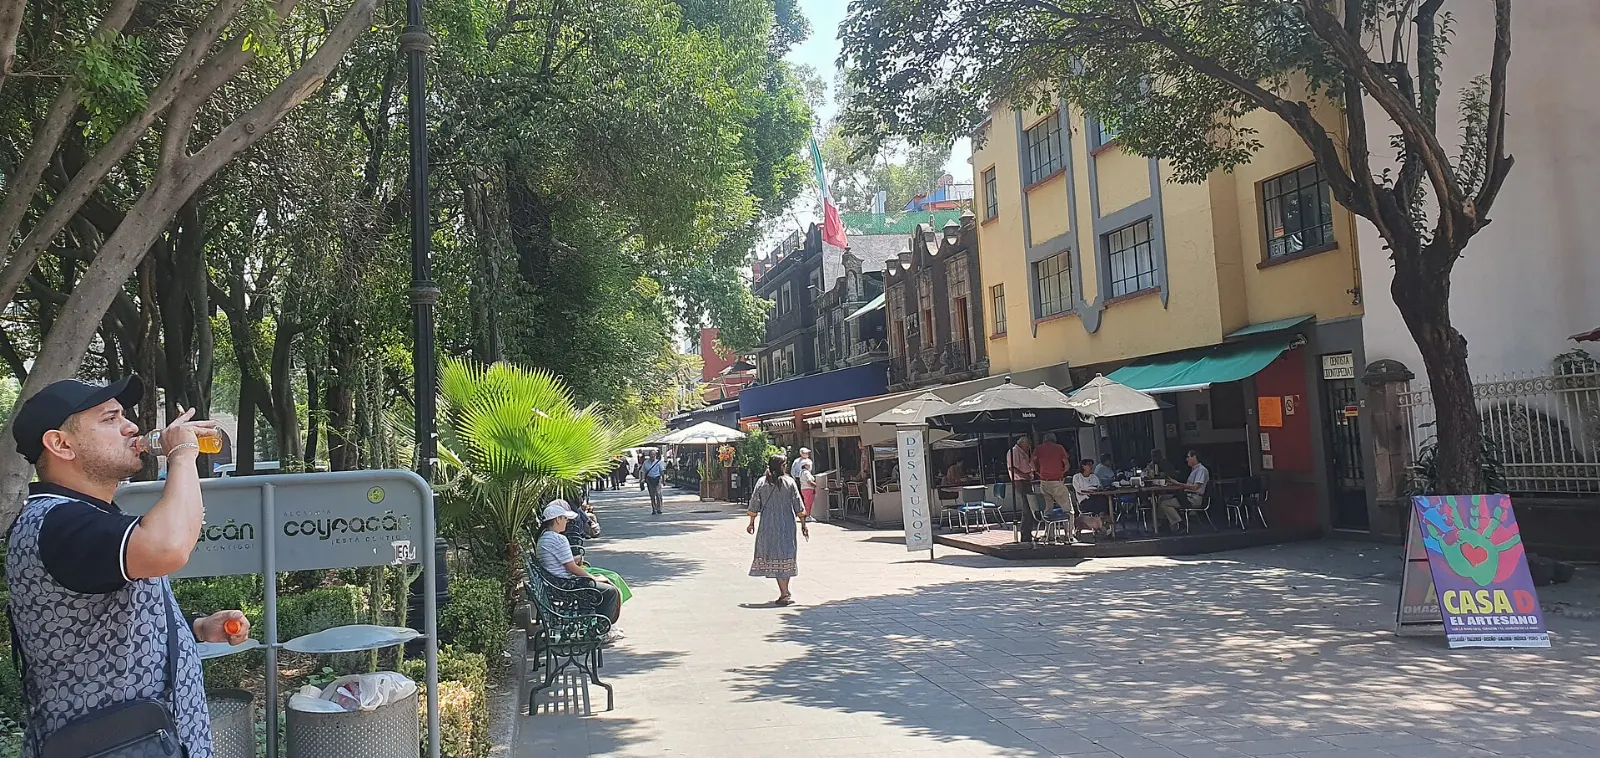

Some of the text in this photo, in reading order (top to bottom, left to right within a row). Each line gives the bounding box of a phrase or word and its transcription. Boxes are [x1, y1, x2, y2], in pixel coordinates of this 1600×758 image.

[906, 437, 923, 542] DESAYUNOS
[1443, 589, 1514, 614] CASA
[1512, 589, 1535, 614] D
[1449, 615, 1538, 626] EL ARTESANO
